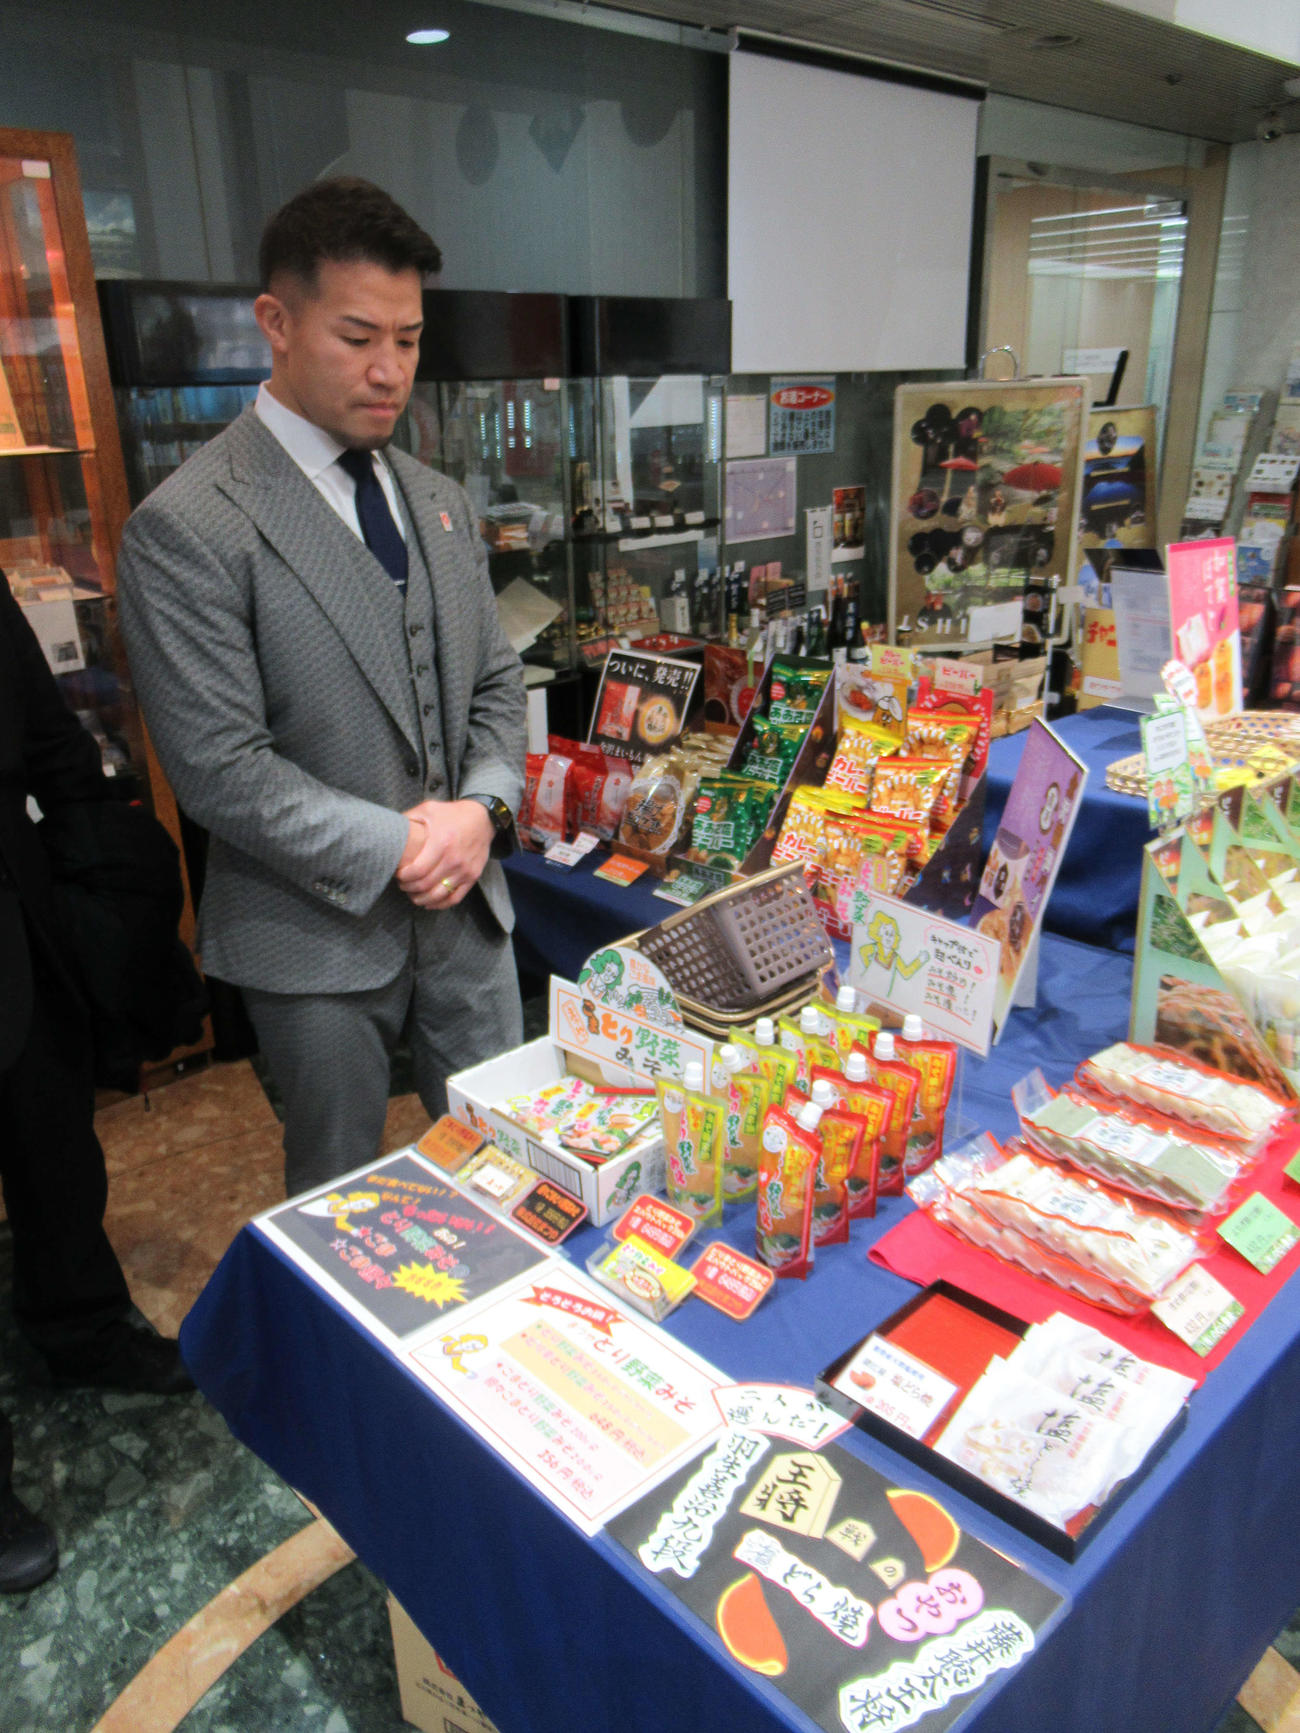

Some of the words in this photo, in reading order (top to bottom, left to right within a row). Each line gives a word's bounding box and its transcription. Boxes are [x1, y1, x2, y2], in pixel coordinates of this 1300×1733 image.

[833, 756, 866, 777] カレー
[650, 1434, 761, 1576] 羽生善治九段
[883, 1564, 897, 1578] の
[897, 1579, 968, 1634] おやつ
